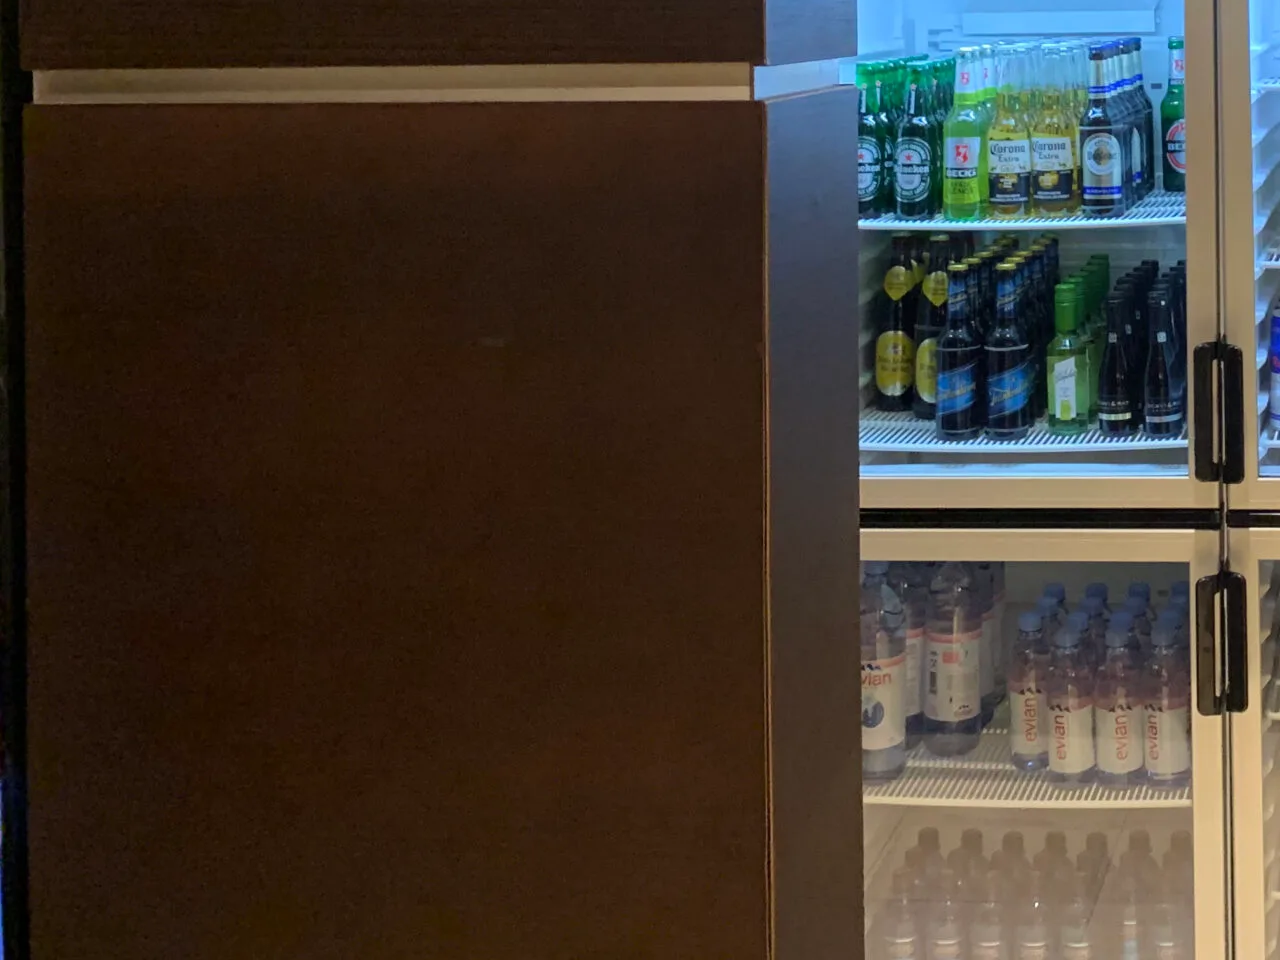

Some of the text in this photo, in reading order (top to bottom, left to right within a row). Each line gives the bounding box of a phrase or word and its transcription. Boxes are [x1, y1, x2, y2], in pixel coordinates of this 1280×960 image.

[990, 143, 1026, 155] Corona
[1032, 141, 1066, 152] Corona
[1026, 696, 1037, 741] evian
[1057, 715, 1066, 760] evian
[1116, 715, 1128, 761] evian
[1148, 714, 1157, 760] evian
